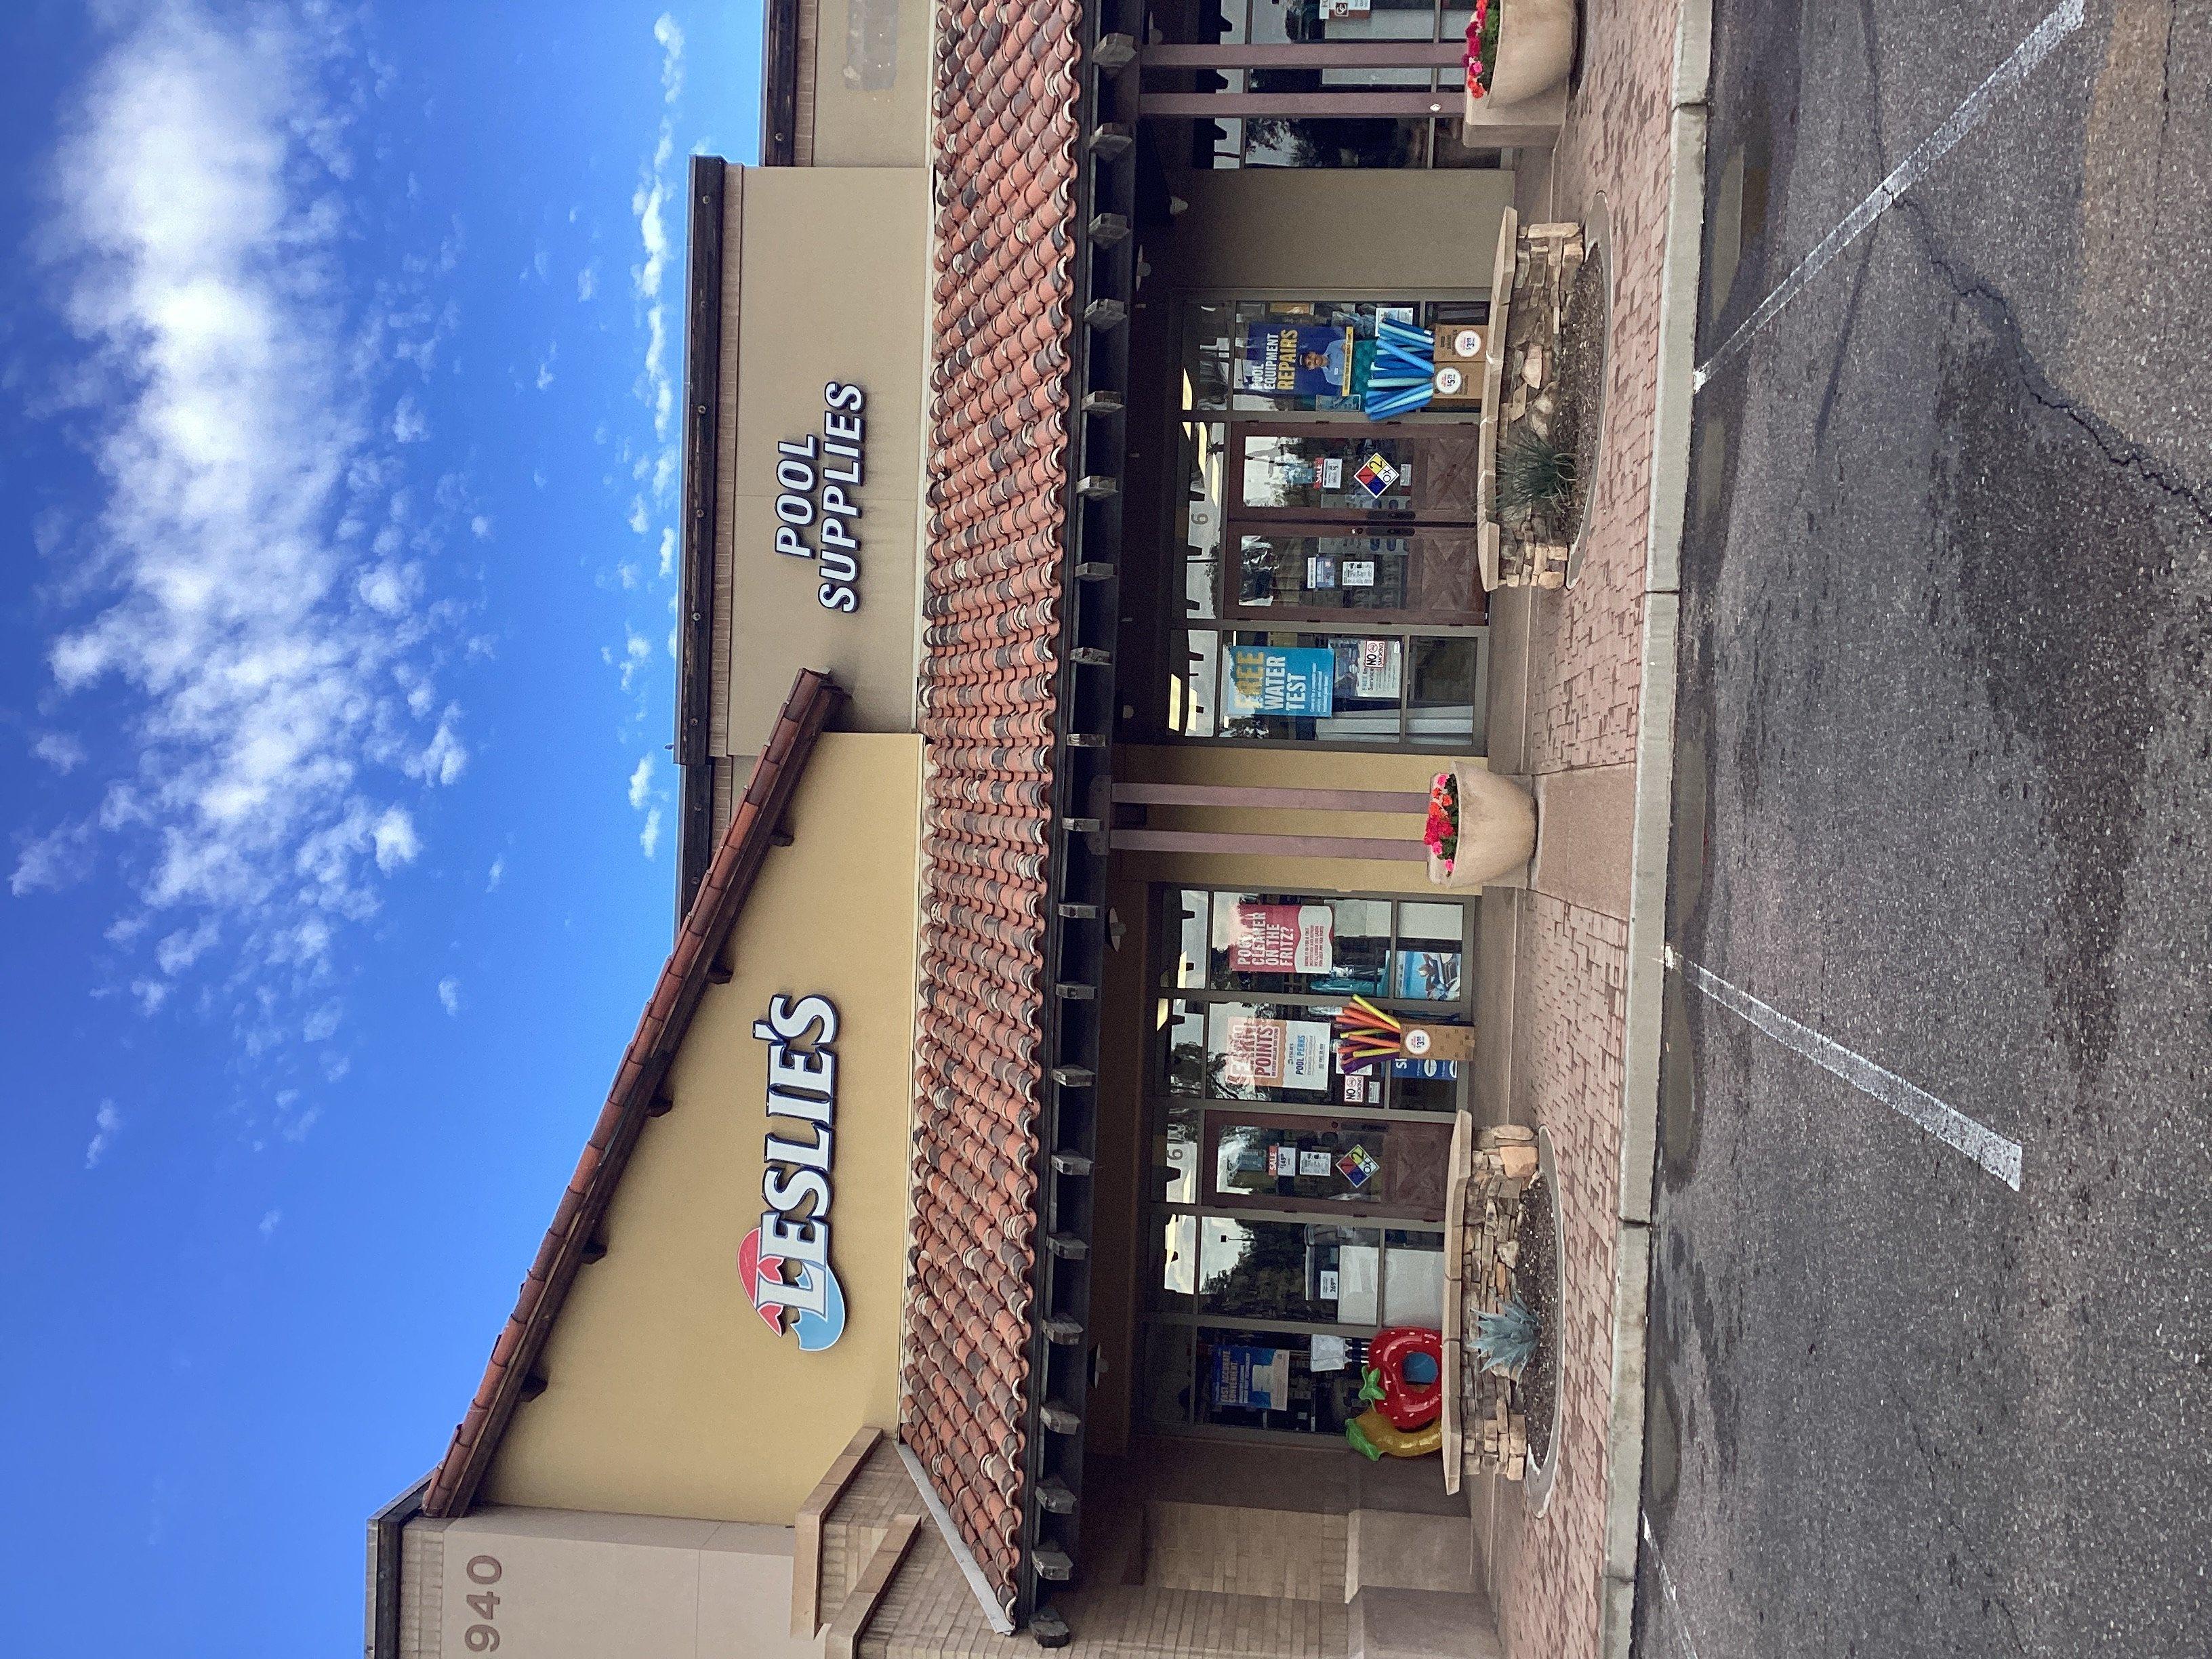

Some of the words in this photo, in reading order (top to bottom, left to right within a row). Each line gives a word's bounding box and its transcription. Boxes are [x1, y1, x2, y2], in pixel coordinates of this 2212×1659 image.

[1264, 333, 1279, 390] EQUIPMENT
[1277, 329, 1298, 390] REPAIRS
[1249, 363, 1265, 390] POOL
[1369, 460, 1382, 468] 2
[1382, 469, 1391, 483] OX
[775, 434, 818, 559] POOL
[818, 382, 865, 613] SUPPLIES
[1191, 514, 1208, 525] 6
[1366, 653, 1377, 665] NO
[1234, 651, 1264, 709] FREE
[1265, 656, 1286, 710] WATER
[1286, 672, 1307, 711] TEST
[1251, 912, 1266, 966] CLEANER
[1266, 924, 1280, 946] THE
[1279, 926, 1294, 966] FRITZ?
[1265, 949, 1279, 966] ON
[1254, 1027, 1273, 1076] POINTS
[1296, 1036, 1305, 1057] PERKS
[1295, 1057, 1304, 1075] POOL
[1345, 1088, 1356, 1100] NO
[752, 994, 838, 1322] LESLIE'S
[1166, 1149, 1183, 1160] 6
[1351, 1151, 1364, 1160] 2
[1364, 1161, 1372, 1174] OX
[464, 1555, 501, 1652] 940
